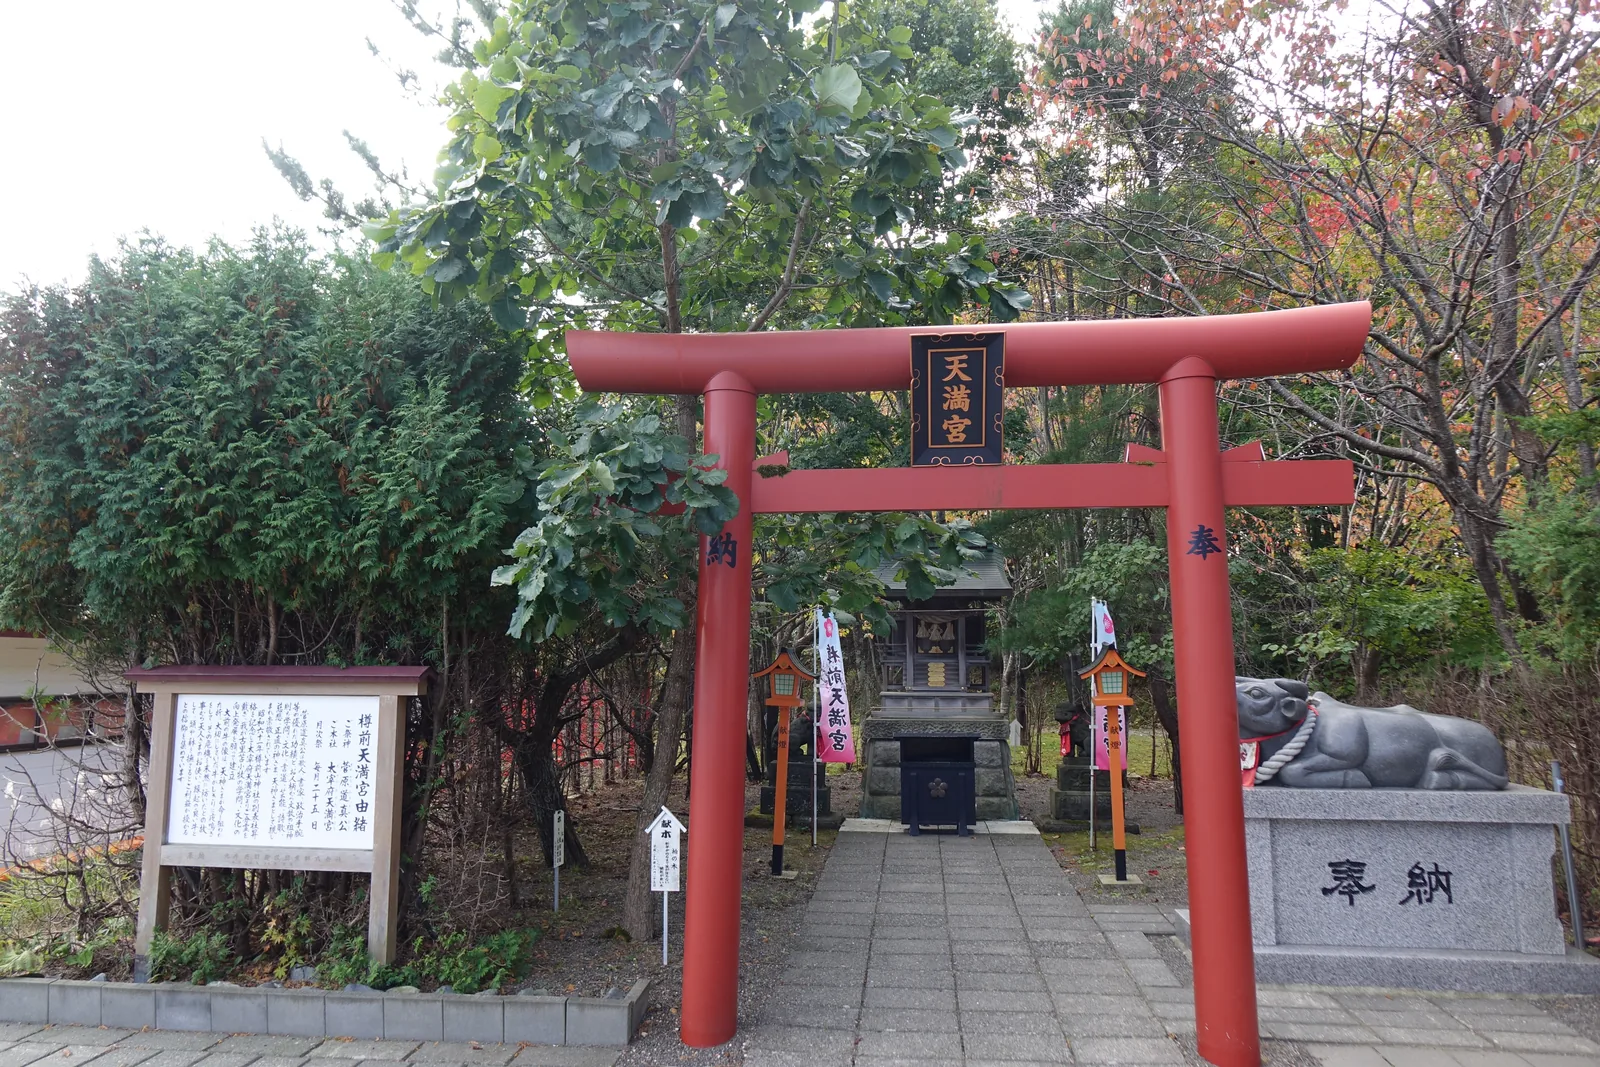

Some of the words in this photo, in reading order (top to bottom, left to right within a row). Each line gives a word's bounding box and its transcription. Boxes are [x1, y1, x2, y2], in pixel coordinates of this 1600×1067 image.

[942, 354, 972, 443] 天満宮
[706, 532, 737, 568] 納
[1186, 524, 1222, 561] 奉
[339, 760, 351, 831] 菅原道真公
[352, 713, 372, 832] 樽前天満宮由緒
[661, 820, 672, 838] 献木
[1321, 858, 1453, 906] 奉納
